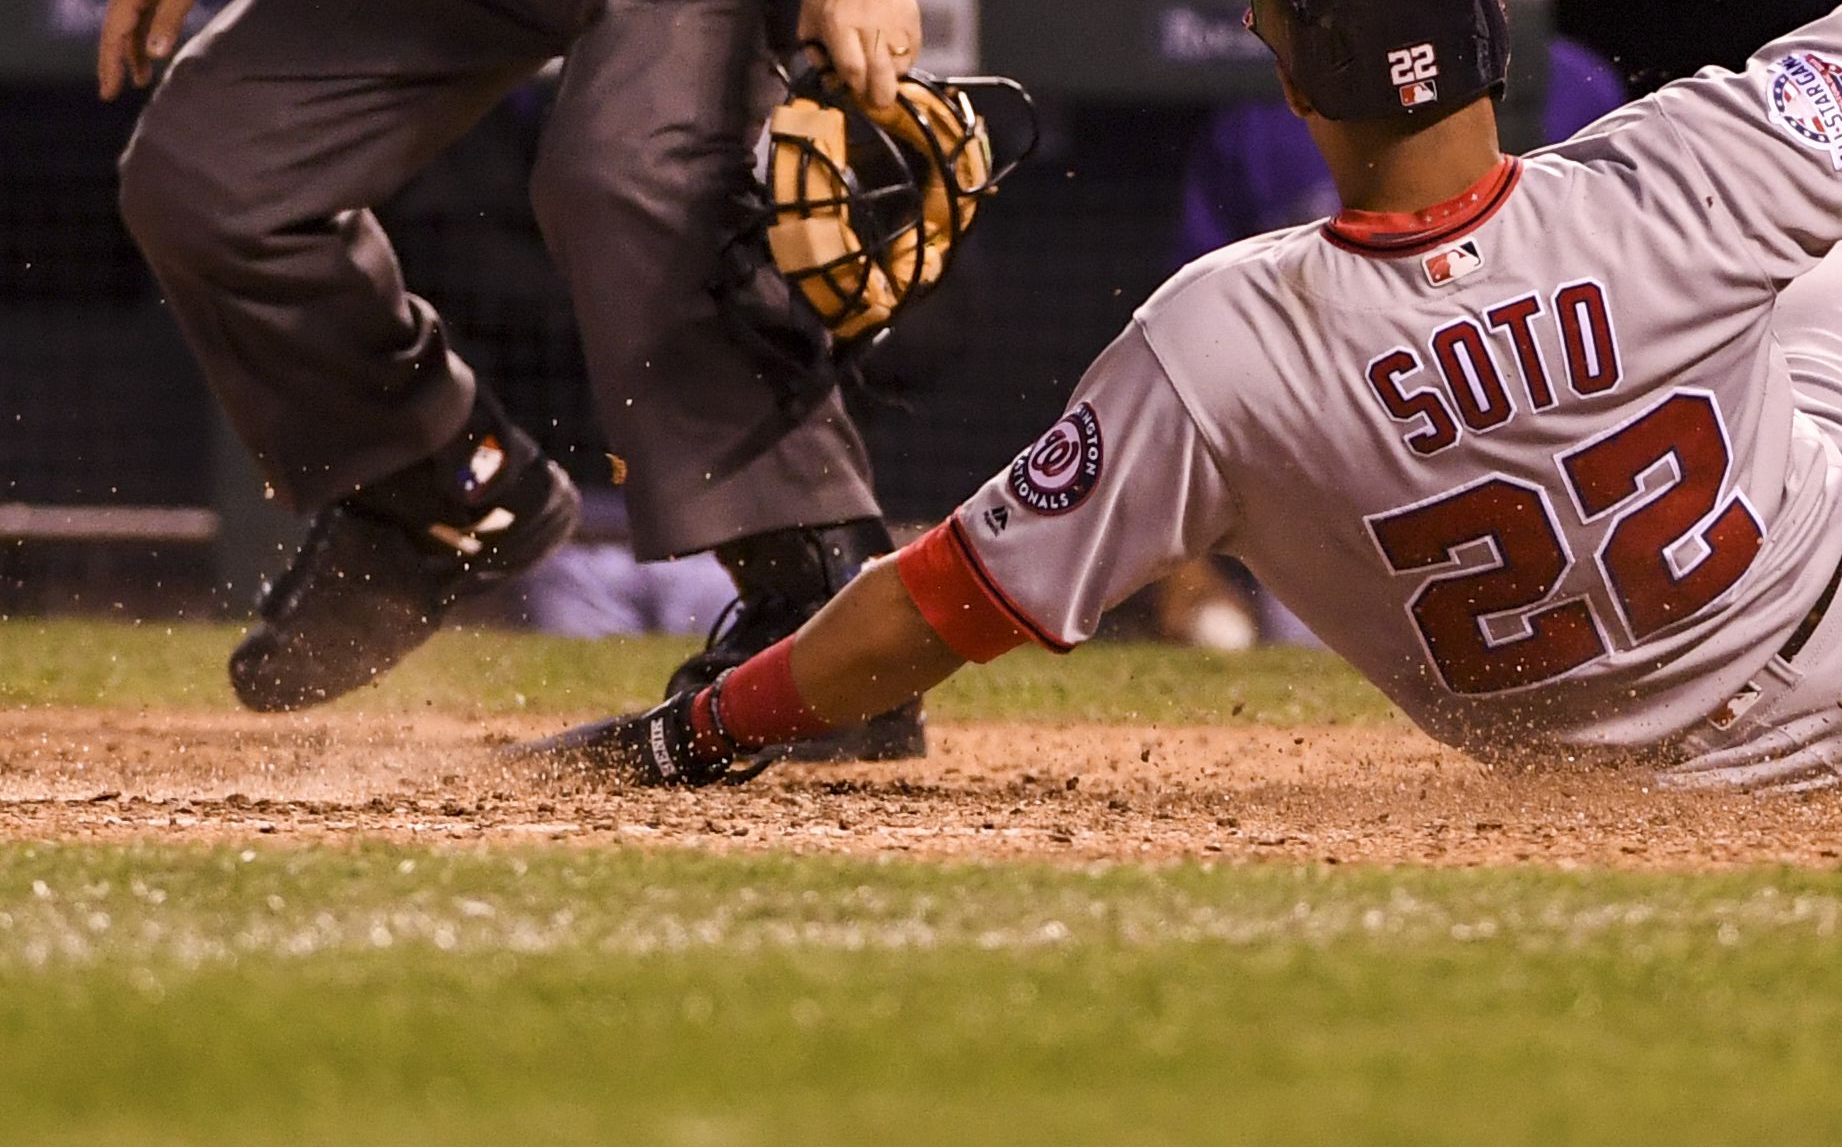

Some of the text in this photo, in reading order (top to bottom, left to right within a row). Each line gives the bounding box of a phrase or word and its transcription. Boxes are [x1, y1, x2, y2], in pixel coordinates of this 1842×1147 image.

[1387, 43, 1438, 86] 22
[1365, 277, 1624, 457] SOTO
[1363, 387, 1768, 698] 22
